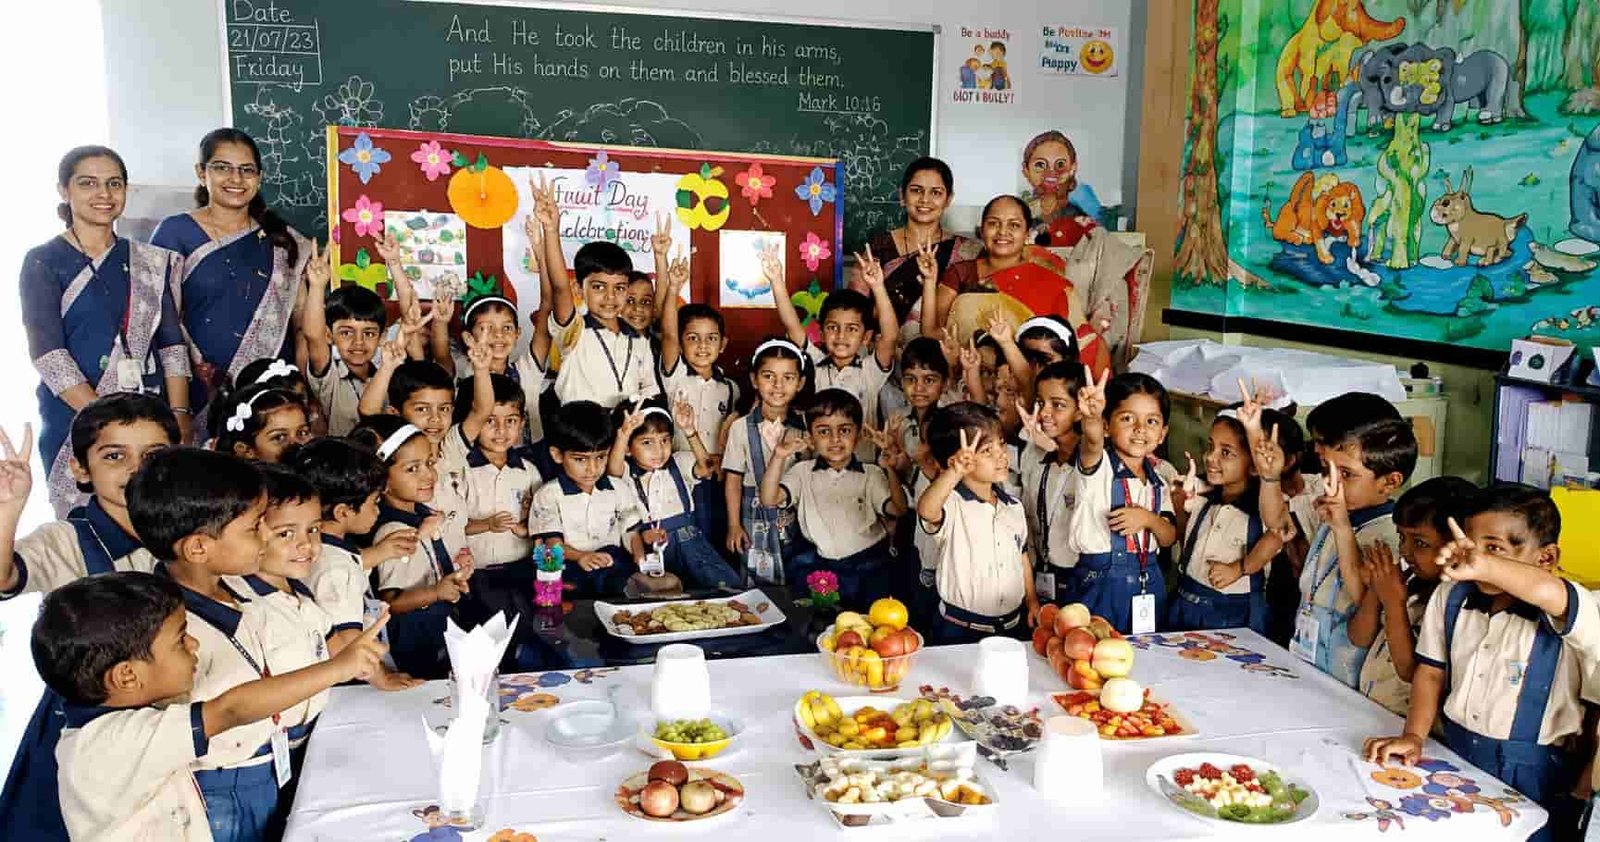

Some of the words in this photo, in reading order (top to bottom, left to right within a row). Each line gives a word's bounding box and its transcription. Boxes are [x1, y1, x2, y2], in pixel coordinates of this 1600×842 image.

[233, 0, 292, 22] Date
[231, 28, 313, 51] 21/07/23
[446, 14, 493, 43] And
[511, 20, 540, 45] He
[555, 23, 598, 48] took
[611, 27, 642, 50] the
[653, 29, 726, 54] children
[736, 37, 753, 55] in
[762, 35, 786, 58] his
[795, 46, 843, 65] arms,
[236, 54, 303, 90] Friday
[449, 53, 482, 81] put
[493, 53, 523, 75] His
[534, 54, 588, 78] hands
[599, 65, 620, 79] on
[629, 59, 675, 81] them
[685, 63, 718, 82] and
[729, 62, 789, 86] blessed
[800, 66, 845, 88] them.
[798, 92, 838, 111] Mark
[845, 95, 881, 112] 10:16
[608, 180, 649, 220] Day
